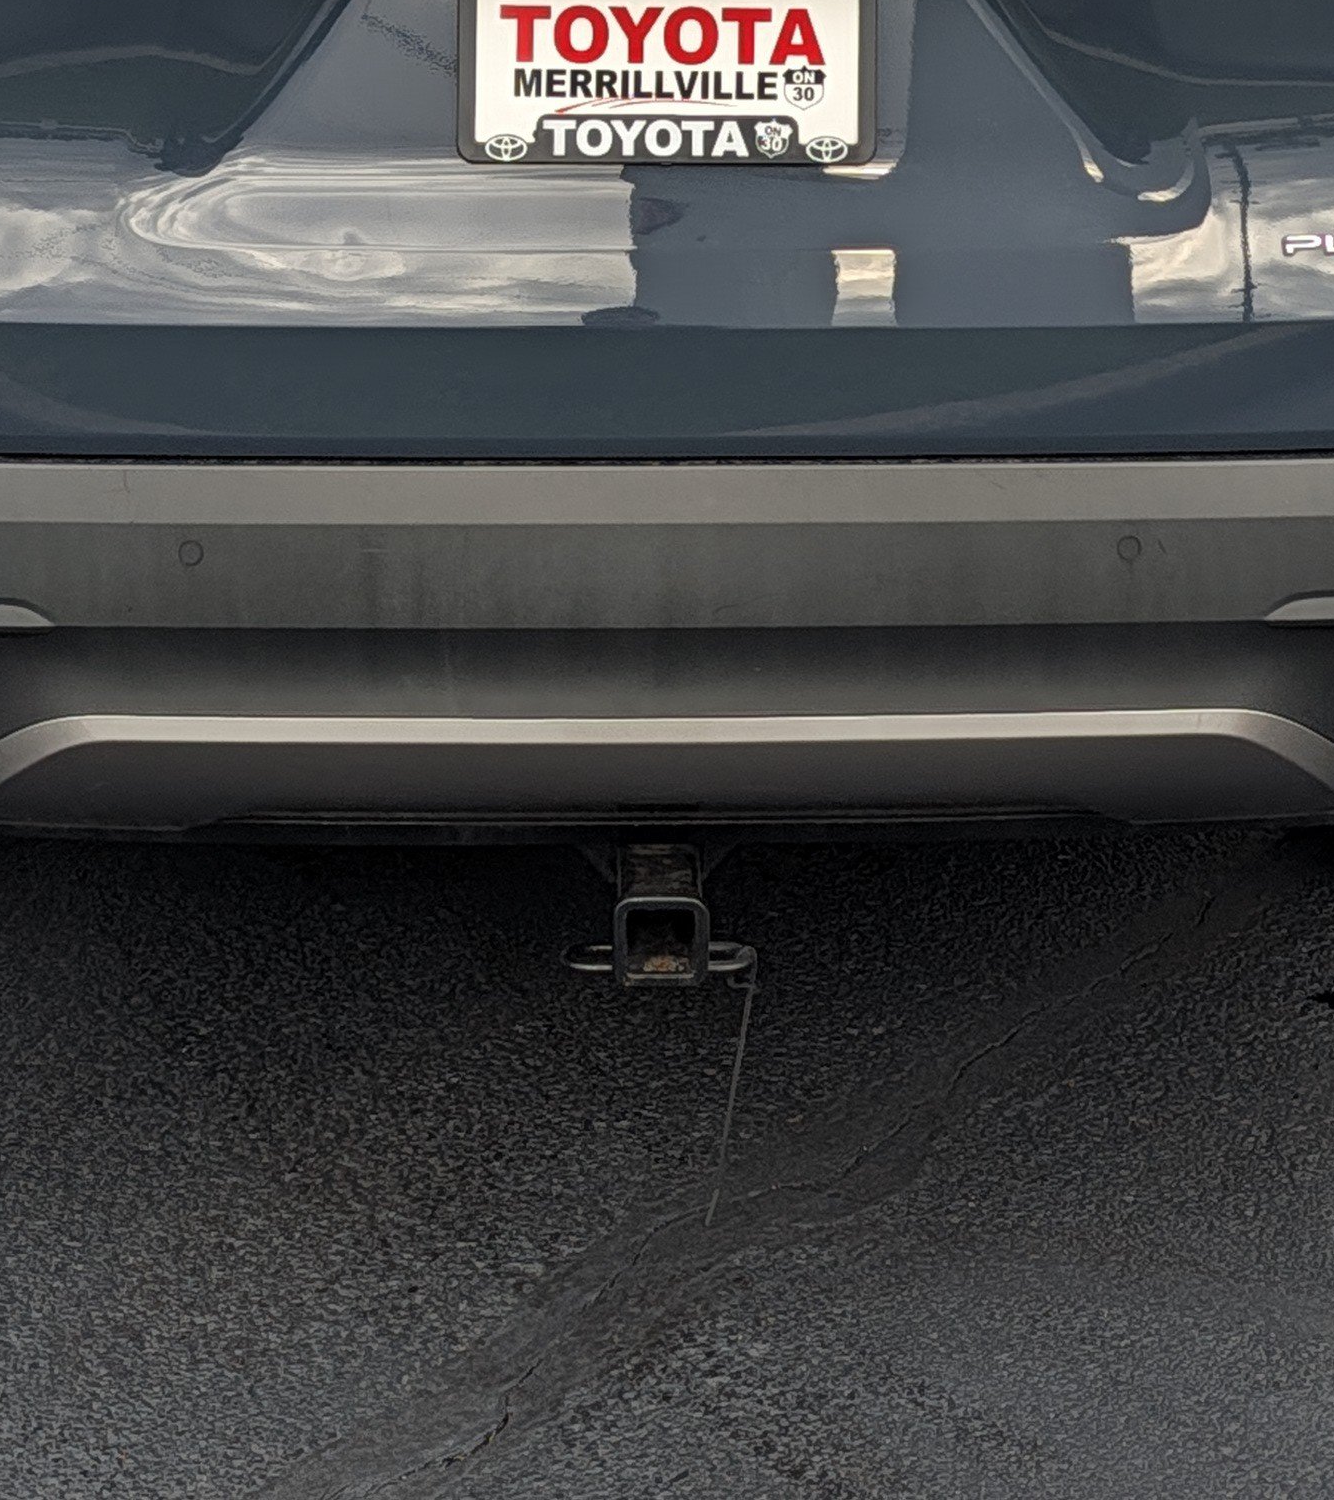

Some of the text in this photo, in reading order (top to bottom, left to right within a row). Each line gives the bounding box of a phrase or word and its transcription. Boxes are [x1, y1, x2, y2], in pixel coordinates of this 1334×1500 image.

[500, 4, 826, 66] TOYOTA
[513, 68, 779, 101] MERRILLVILLE
[792, 71, 816, 84] ON
[792, 86, 815, 102] 30
[543, 119, 750, 158] TOYOTA
[758, 134, 783, 152] 30
